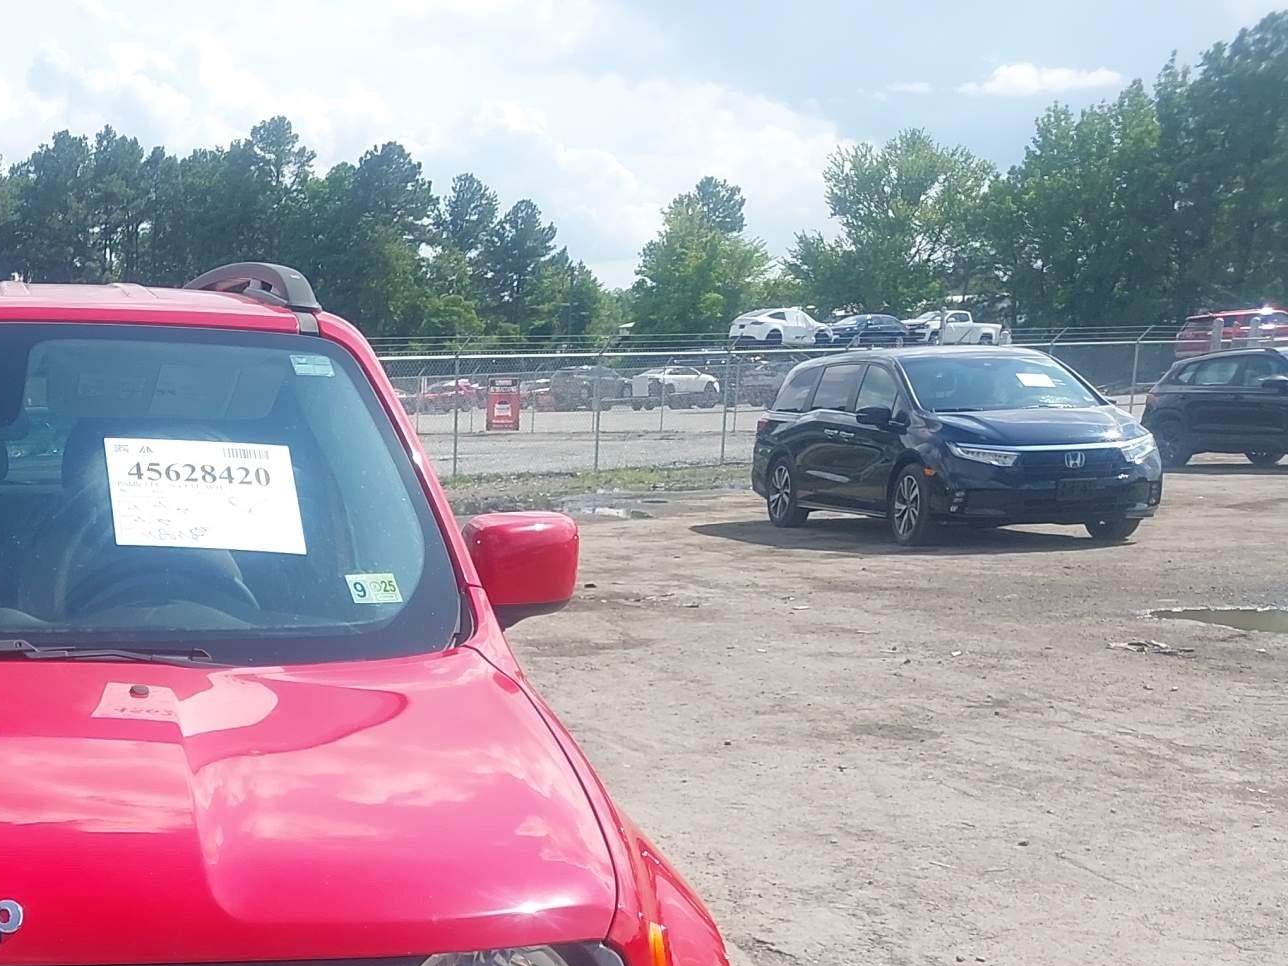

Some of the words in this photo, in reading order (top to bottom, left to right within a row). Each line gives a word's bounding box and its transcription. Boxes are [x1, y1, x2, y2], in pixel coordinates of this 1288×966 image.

[128, 461, 271, 487] 45628420
[353, 582, 366, 598] 9
[380, 580, 396, 593] 25
